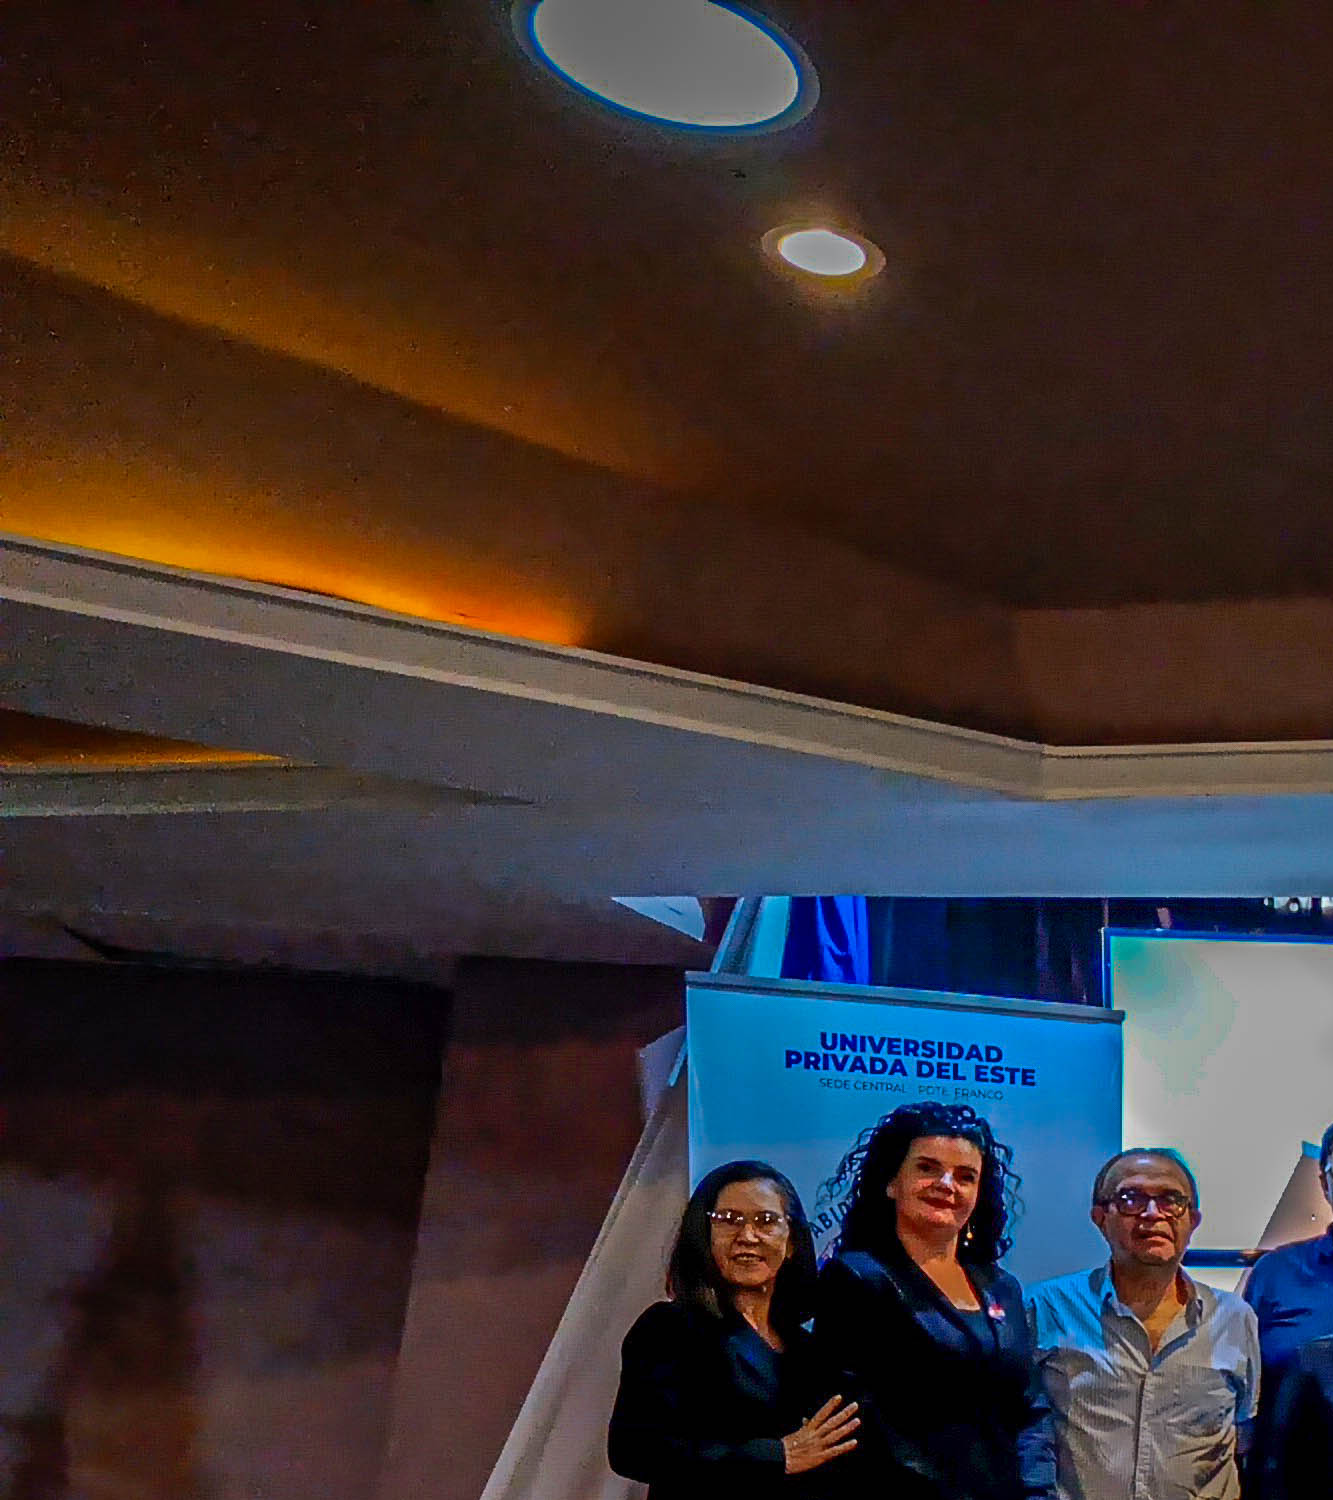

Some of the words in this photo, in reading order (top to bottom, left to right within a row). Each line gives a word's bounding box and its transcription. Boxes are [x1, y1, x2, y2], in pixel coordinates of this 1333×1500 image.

[820, 1032, 1003, 1063] UNIVERSIDAD
[785, 1050, 908, 1077] PRIVADA
[916, 1061, 966, 1081] DEL
[974, 1065, 1036, 1087] ESTE
[819, 1077, 850, 1090] SEDE
[853, 1081, 907, 1094] CENTRAL
[954, 1087, 1004, 1101] FRANCO
